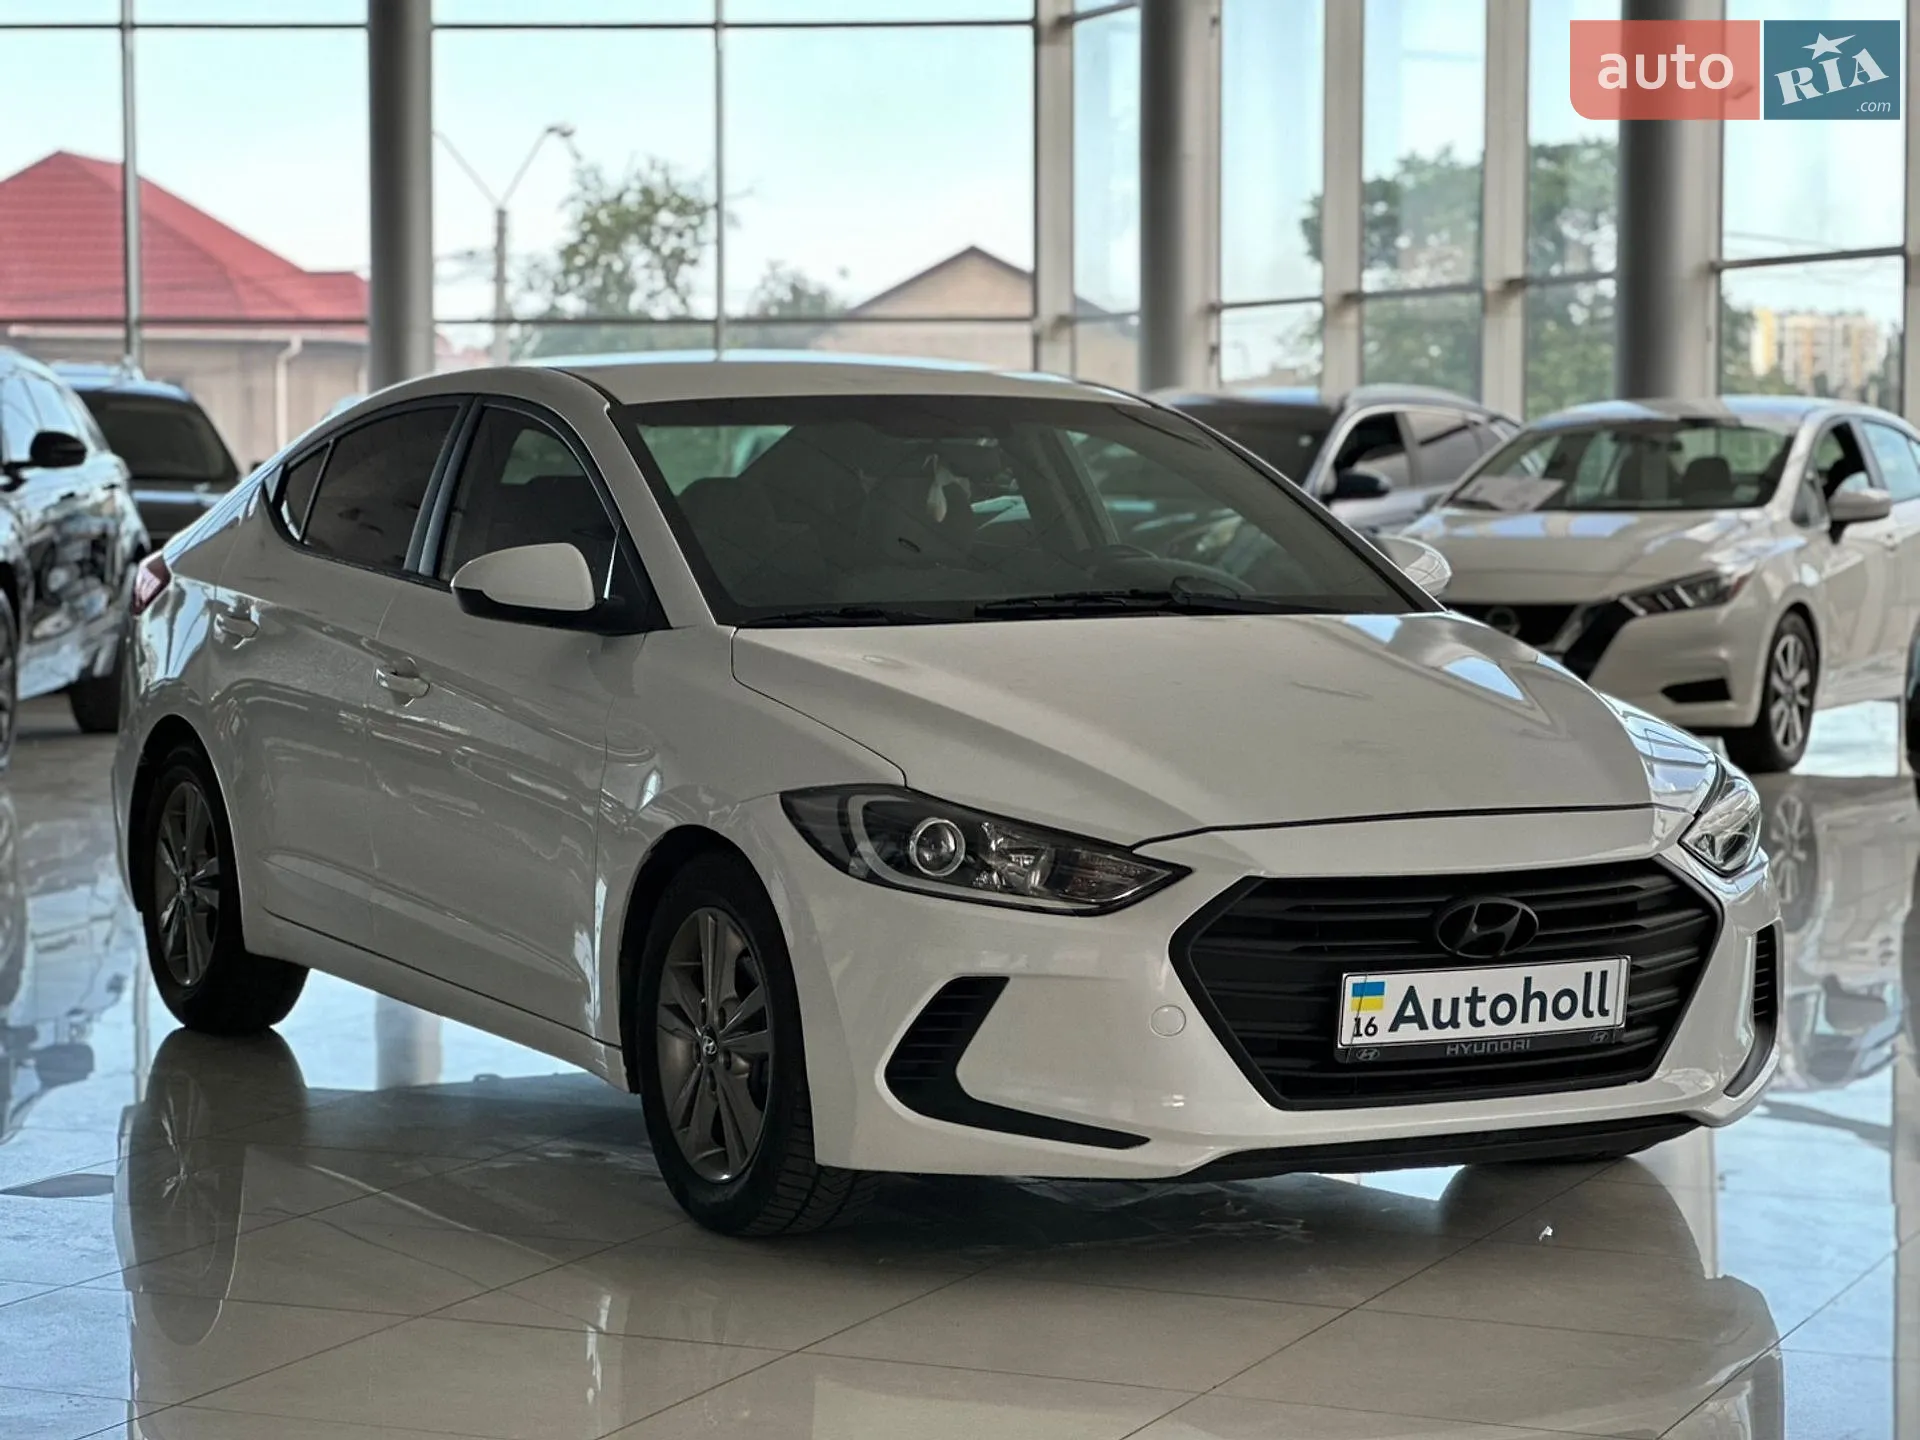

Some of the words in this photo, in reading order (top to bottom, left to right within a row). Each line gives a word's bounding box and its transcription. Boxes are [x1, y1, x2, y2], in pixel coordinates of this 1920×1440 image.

[1388, 970, 1610, 1033] Autoholl
[1352, 1016, 1379, 1037] 16
[1446, 1039, 1531, 1056] HYUNDAI
